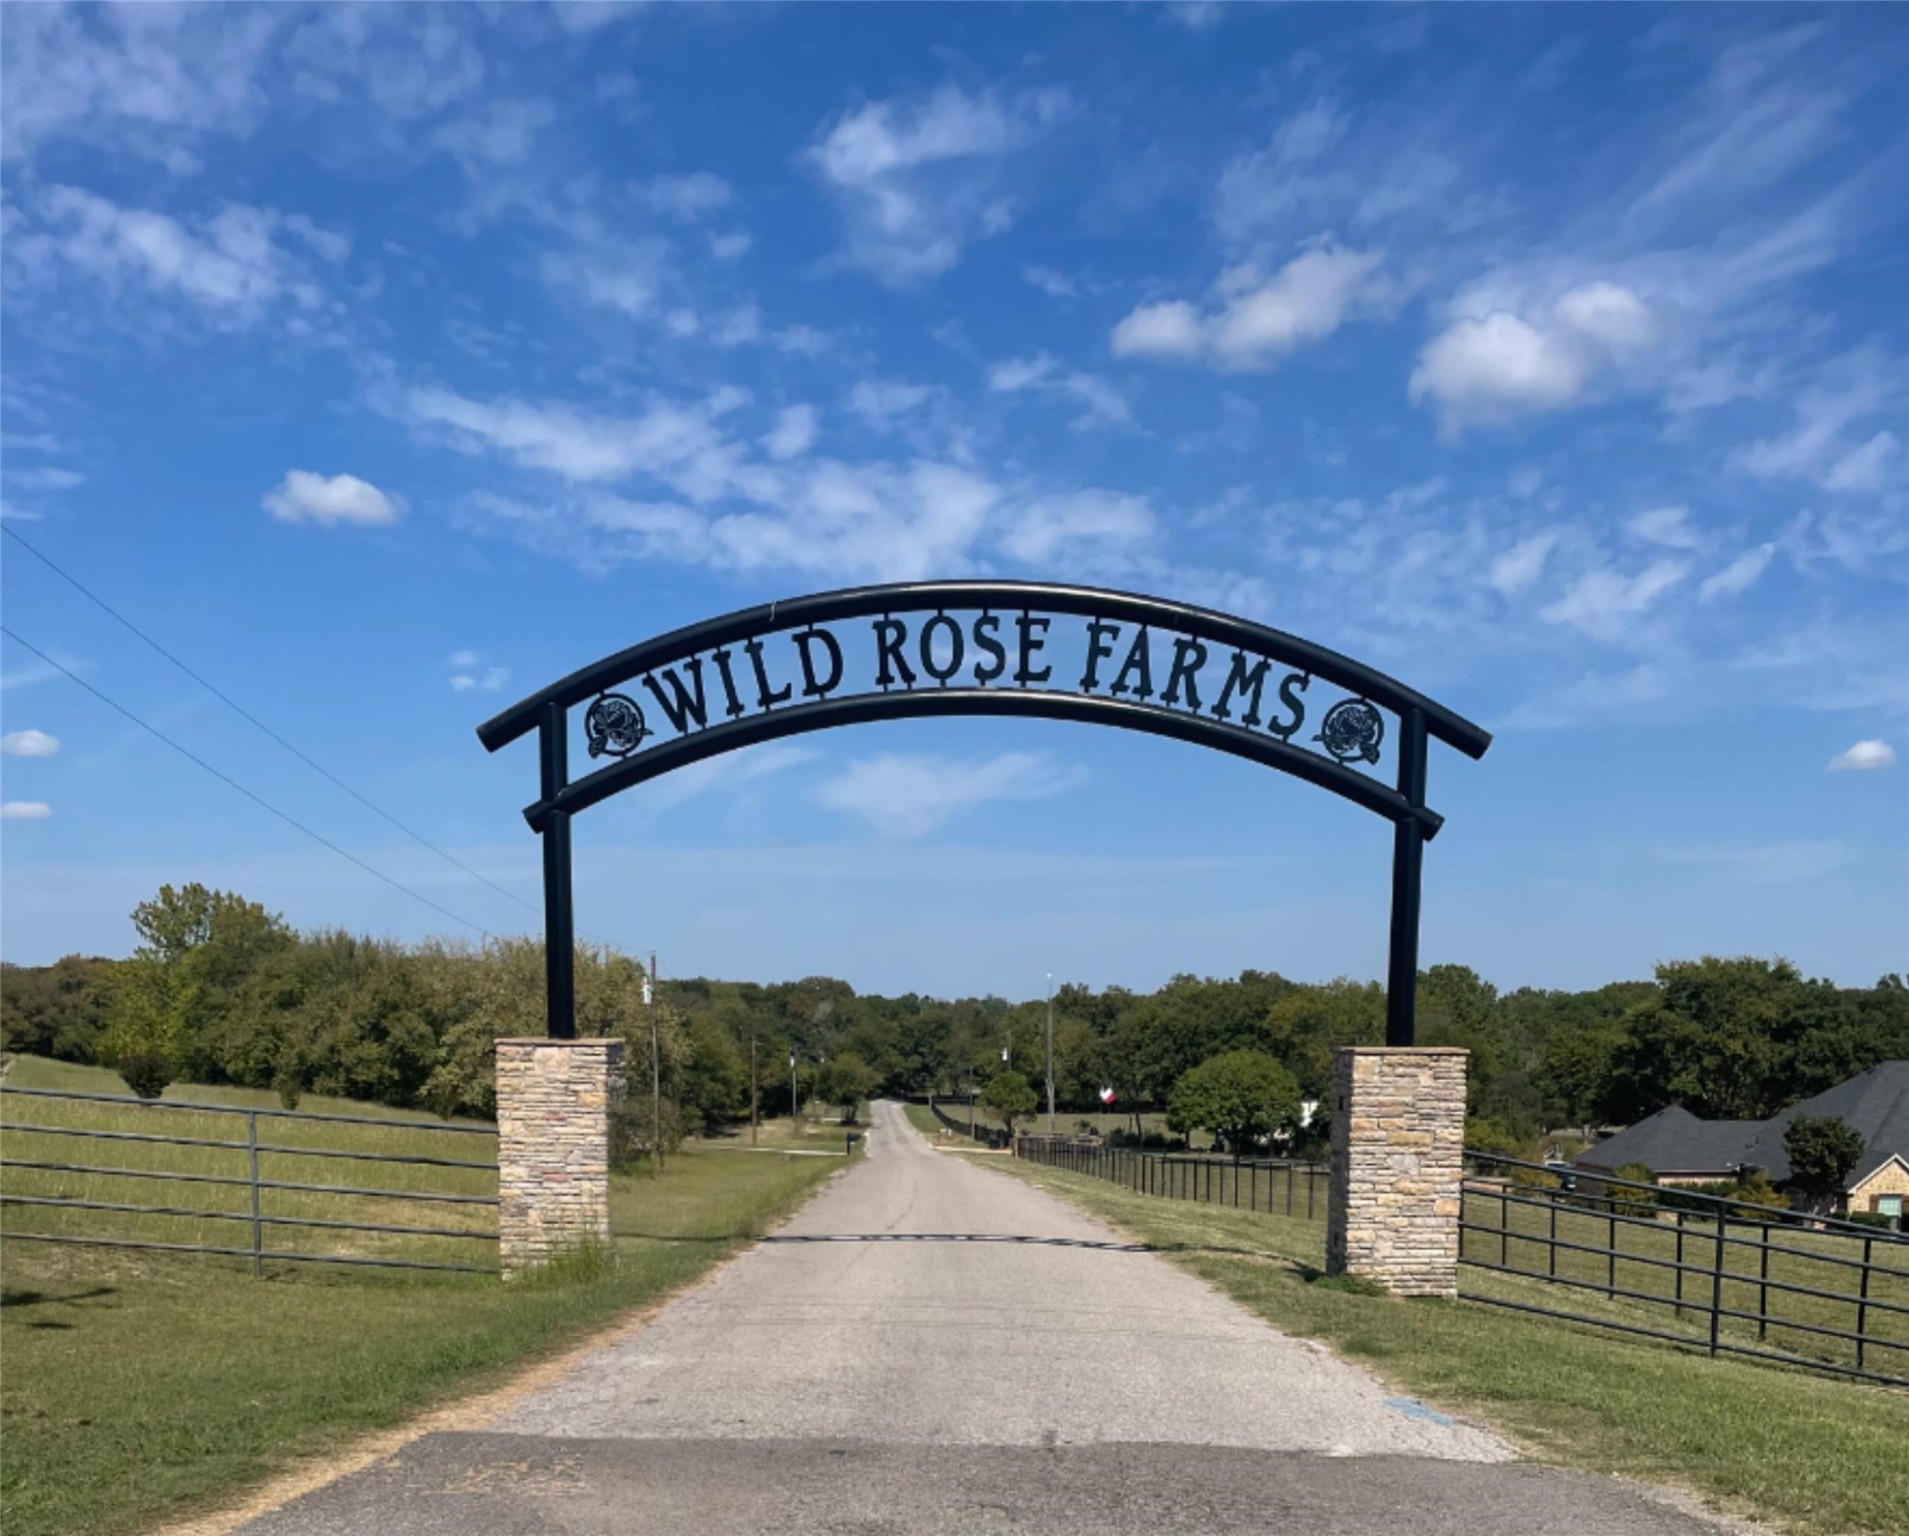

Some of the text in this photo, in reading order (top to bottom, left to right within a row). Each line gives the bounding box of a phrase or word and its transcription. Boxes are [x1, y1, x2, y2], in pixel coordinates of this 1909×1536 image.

[642, 615, 1310, 736] WILD ROSE FARMS
